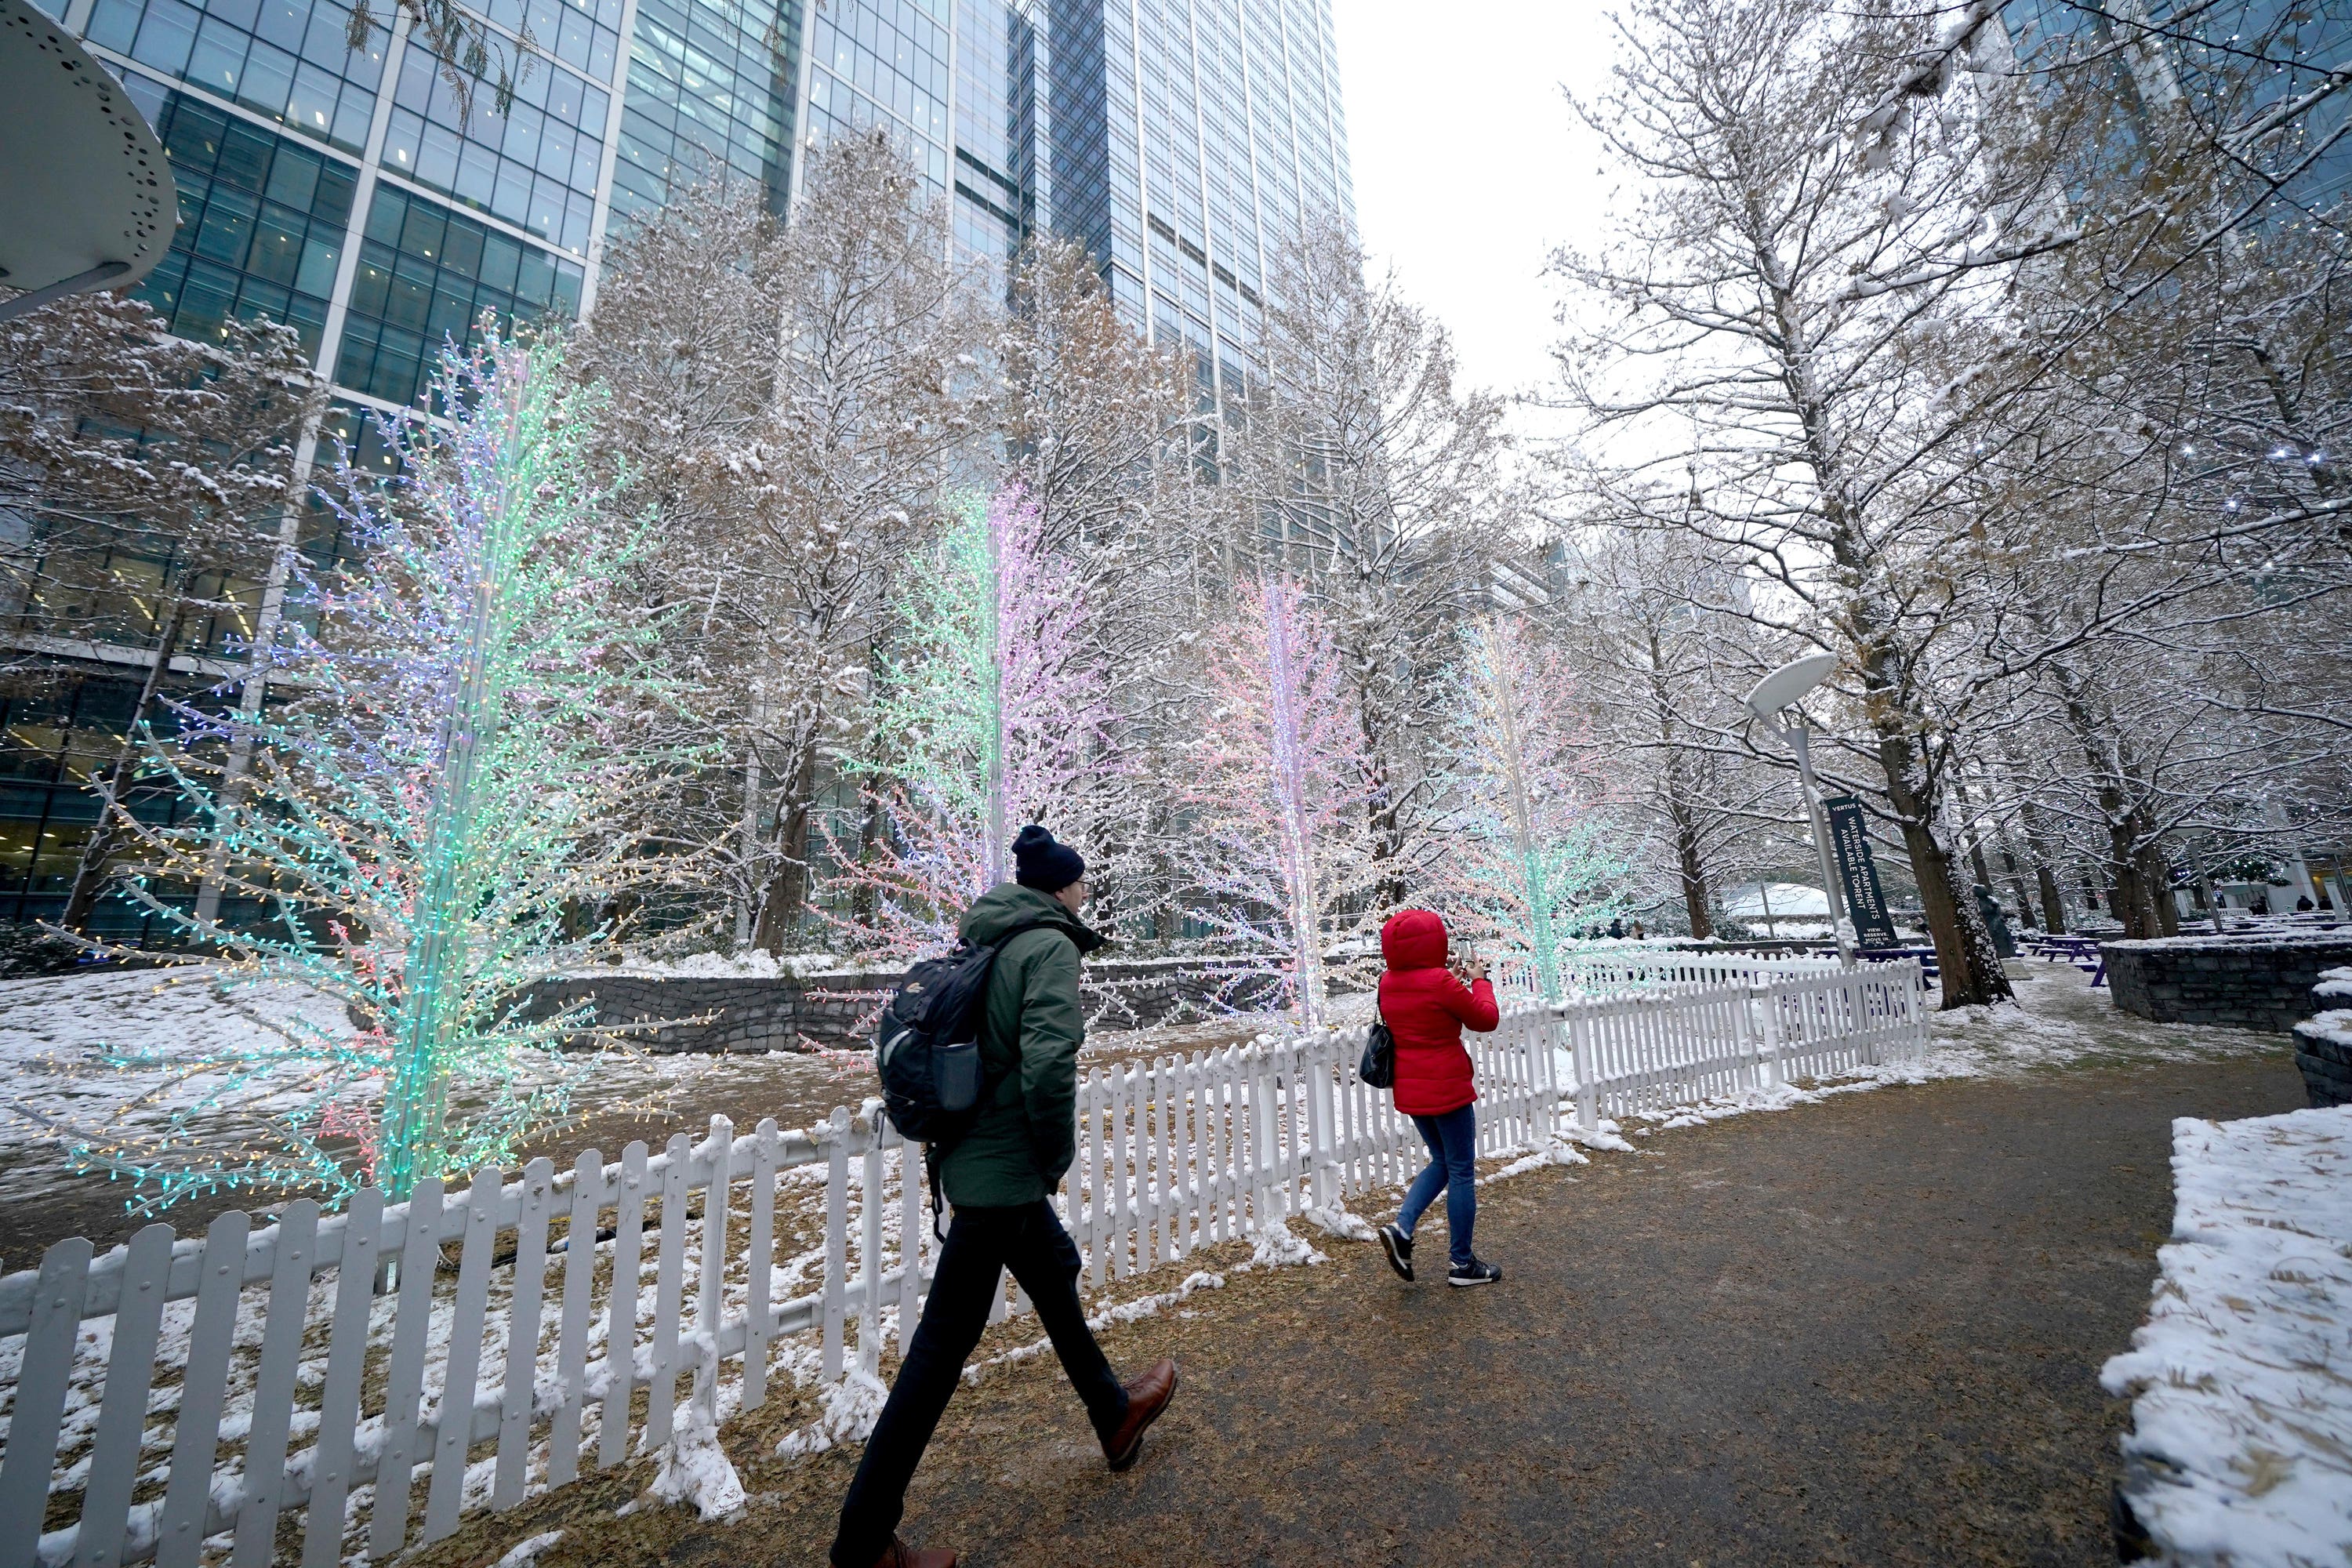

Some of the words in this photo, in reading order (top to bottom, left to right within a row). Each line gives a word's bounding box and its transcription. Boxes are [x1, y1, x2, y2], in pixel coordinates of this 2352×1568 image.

[1832, 803, 1857, 811] VERTUS
[1841, 829, 1857, 872] AVAILABLE
[1848, 816, 1865, 863] WATERSIDE
[1859, 865, 1880, 920] APARTMENTS
[1851, 873, 1860, 886] TO
[1853, 887, 1866, 909] RENT
